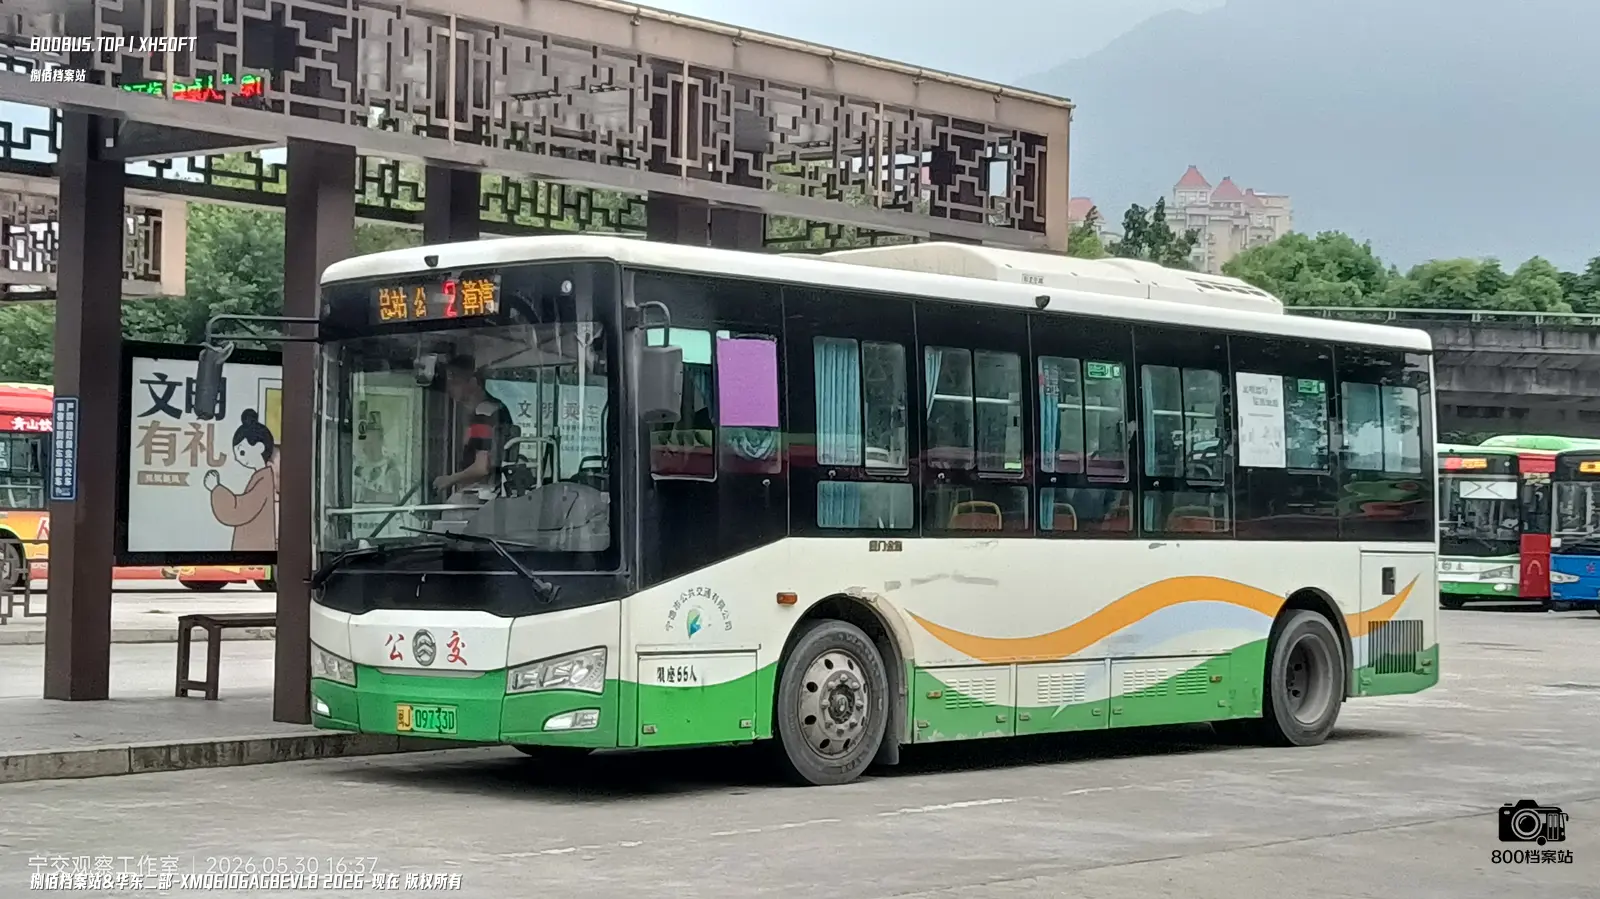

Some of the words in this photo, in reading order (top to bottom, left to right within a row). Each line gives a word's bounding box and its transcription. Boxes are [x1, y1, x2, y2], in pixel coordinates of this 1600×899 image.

[444, 281, 458, 317] 2
[136, 420, 227, 468] 有礼
[385, 634, 405, 661] 公
[446, 630, 468, 666] 交
